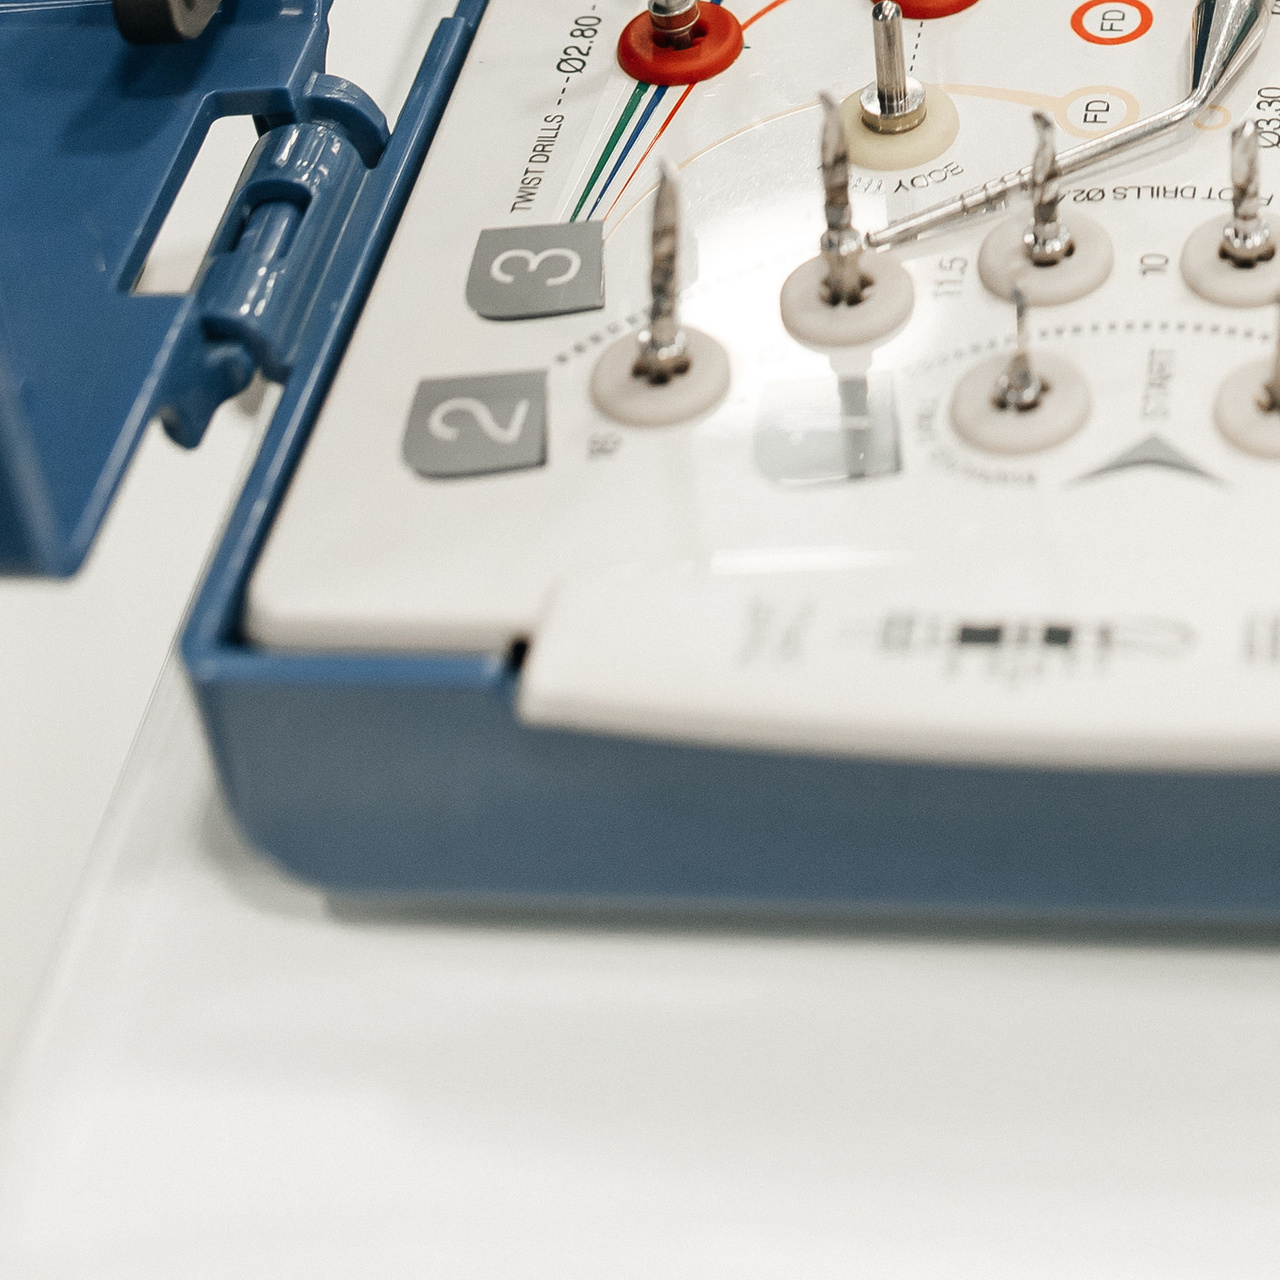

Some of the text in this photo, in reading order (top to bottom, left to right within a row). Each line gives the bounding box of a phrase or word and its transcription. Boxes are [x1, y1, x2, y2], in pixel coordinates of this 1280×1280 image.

[1100, 9, 1124, 32] FD
[510, 15, 602, 214] TWIST DRILLS Ø2.80
[1084, 99, 1110, 124] FD
[893, 161, 964, 193] BODY
[1112, 185, 1197, 201] DRILLS
[489, 246, 581, 287] 3
[1140, 252, 1169, 277] 10
[427, 396, 530, 443] 2
